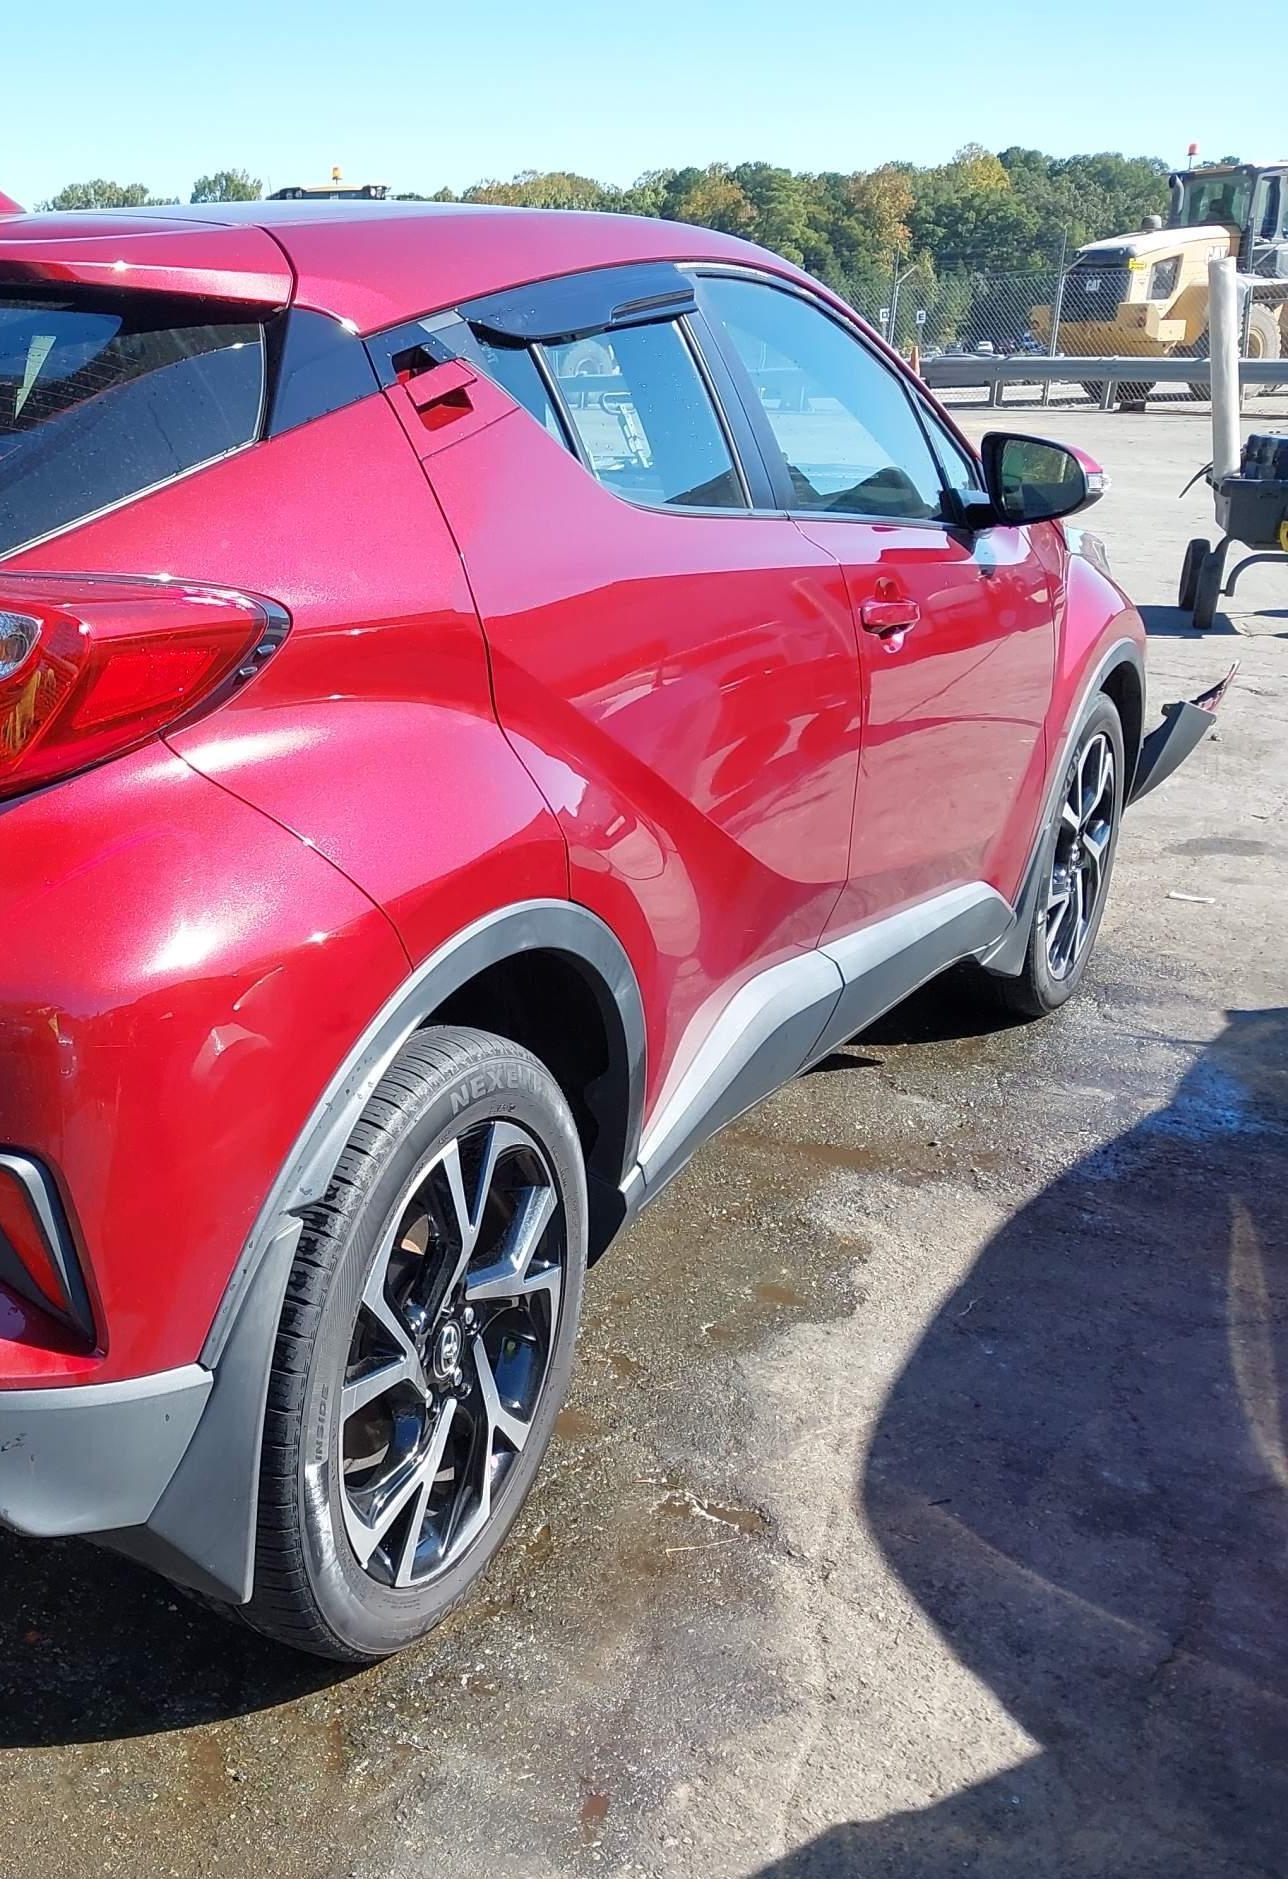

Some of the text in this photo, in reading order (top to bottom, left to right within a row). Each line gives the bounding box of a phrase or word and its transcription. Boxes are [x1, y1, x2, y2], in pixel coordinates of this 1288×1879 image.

[1085, 279, 1102, 291] CAT
[449, 1062, 536, 1116] NEXEN
[315, 1384, 329, 1461] INSIDE
